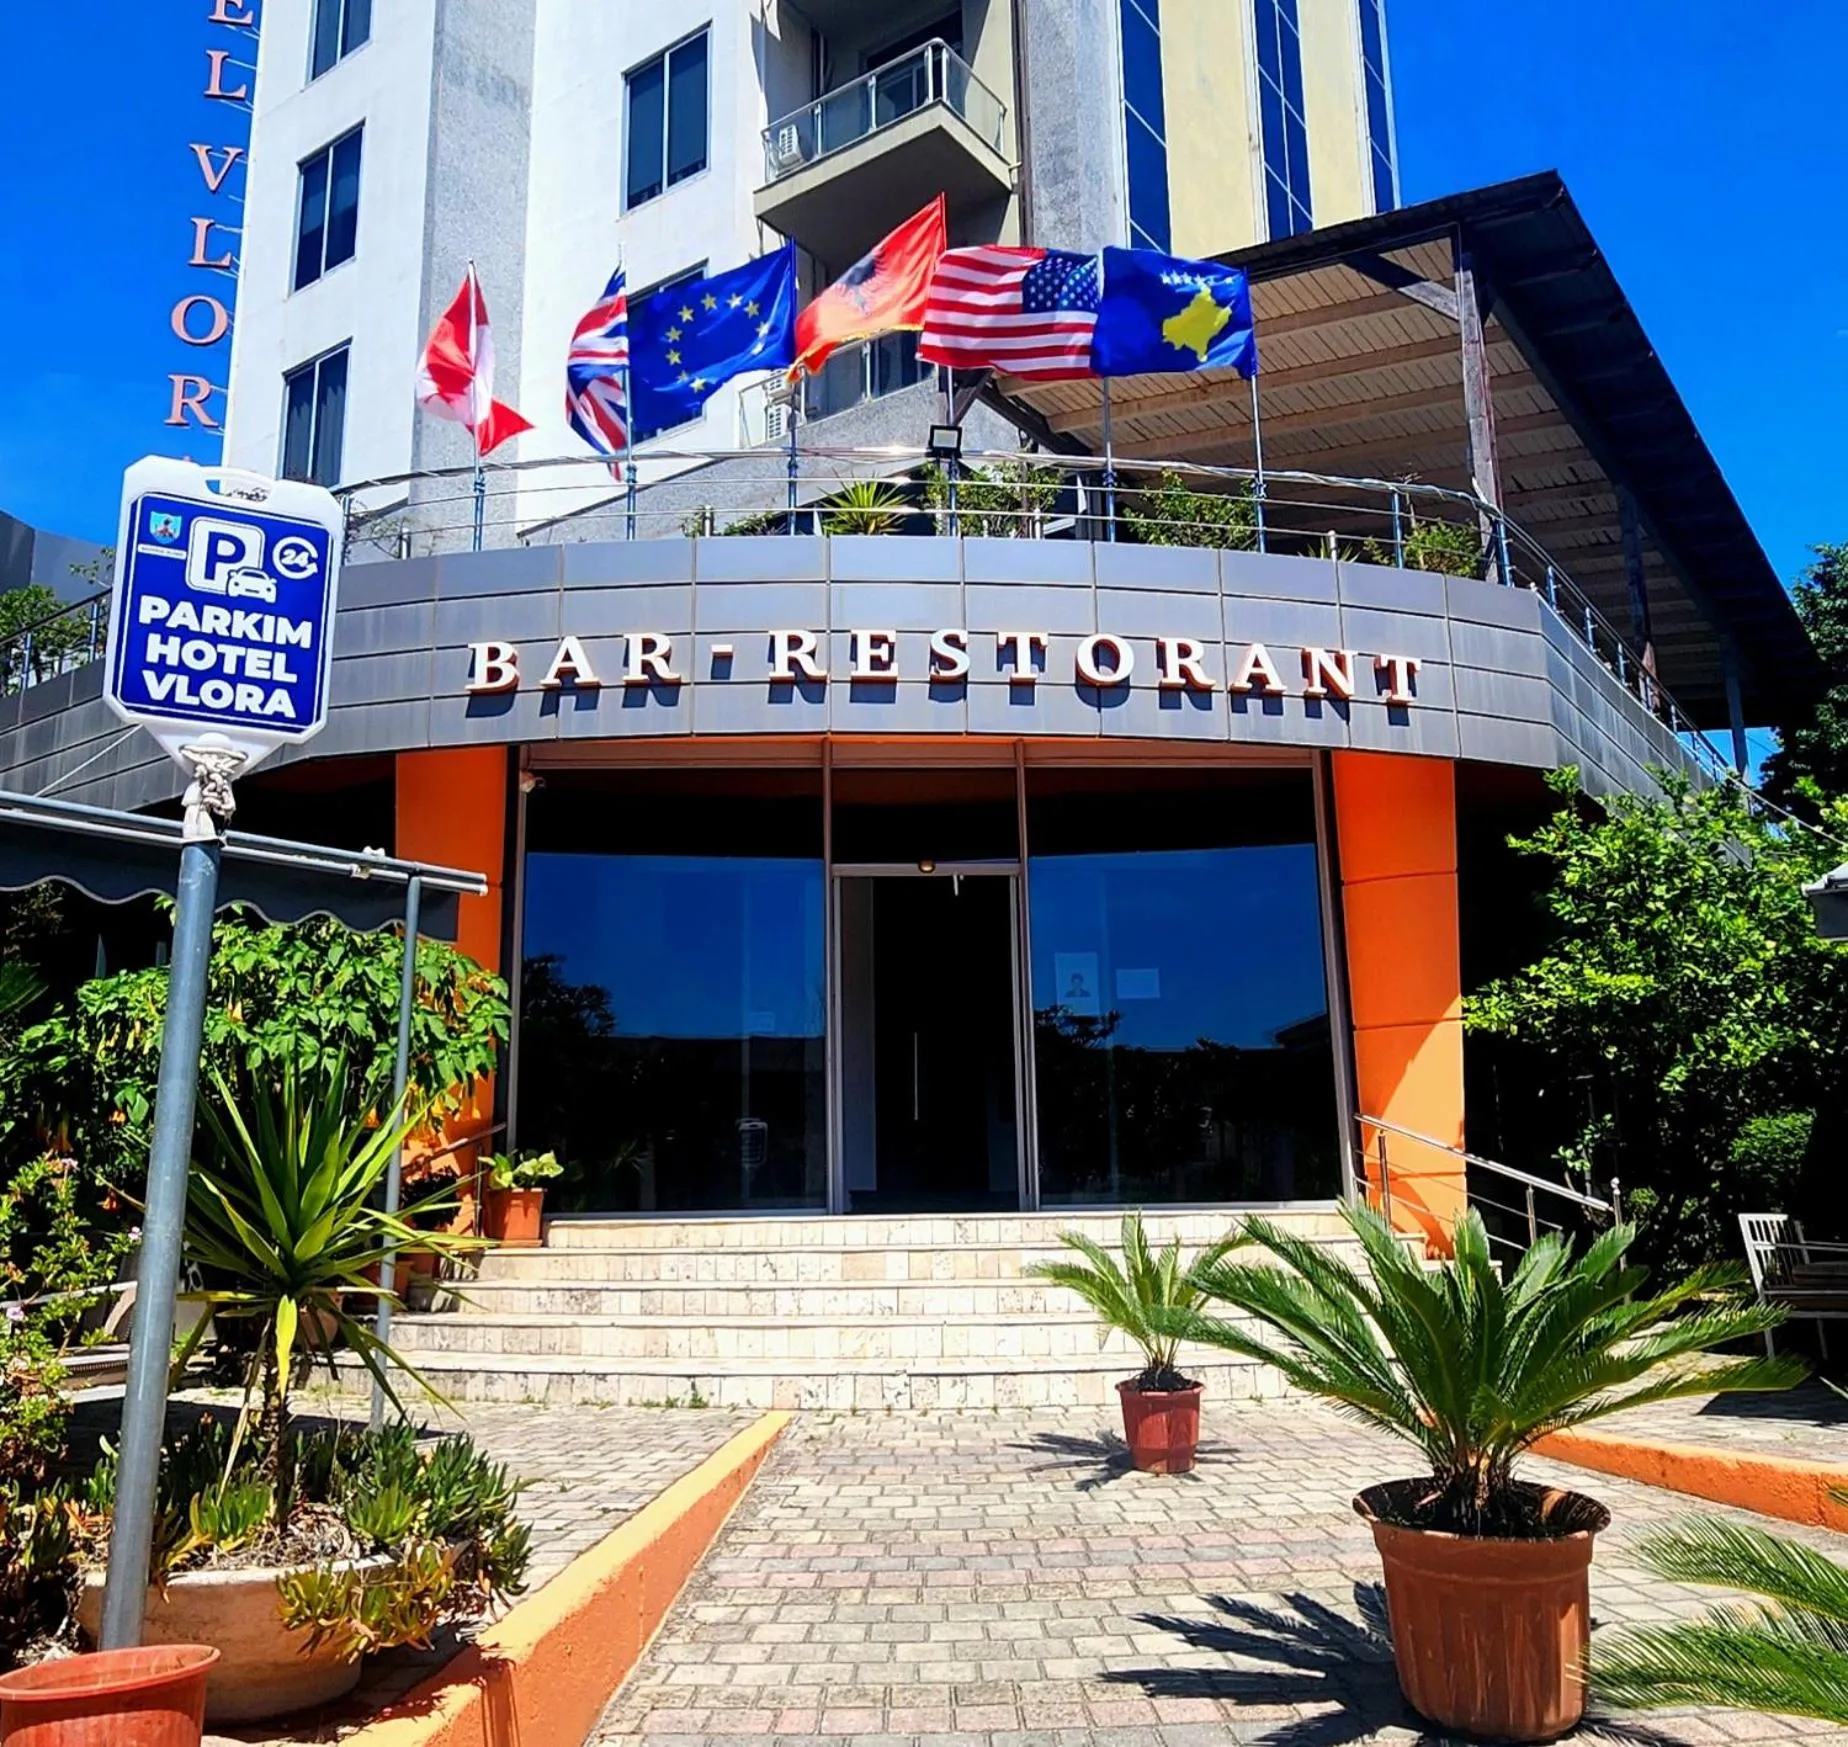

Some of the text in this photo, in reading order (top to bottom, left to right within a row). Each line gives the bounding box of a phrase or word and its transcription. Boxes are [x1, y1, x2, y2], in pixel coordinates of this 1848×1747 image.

[164, 143, 244, 462] VLOR
[204, 531, 246, 583] P
[281, 549, 309, 567] 24
[138, 595, 312, 649] PARKIM
[145, 633, 297, 683] HOTEL
[142, 670, 297, 718] VLORA
